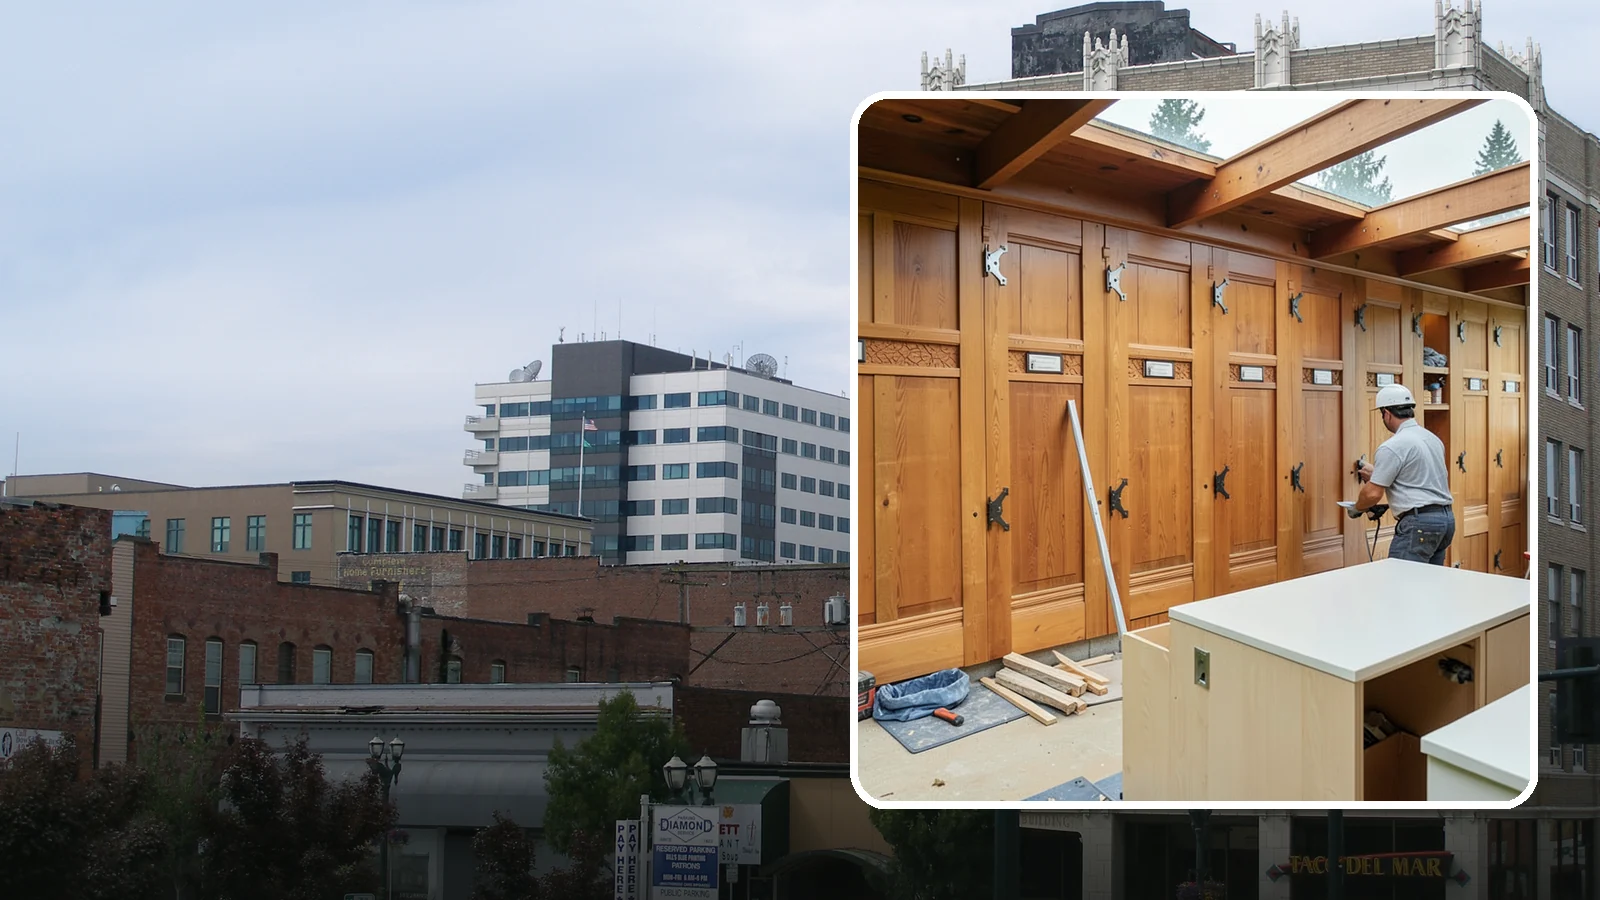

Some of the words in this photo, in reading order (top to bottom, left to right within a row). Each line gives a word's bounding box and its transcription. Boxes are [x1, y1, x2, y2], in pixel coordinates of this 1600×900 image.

[344, 568, 368, 577] Home
[371, 566, 427, 576] Furnishers
[660, 818, 713, 833] DIAMOND
[1021, 815, 1071, 828] BUILDING
[656, 845, 688, 853] RESERVED
[1346, 856, 1385, 876] DEL
[1392, 857, 1442, 877] MAR
[617, 856, 625, 893] HERE
[628, 855, 636, 893] HERE
[660, 888, 682, 897] PUBLIC
[684, 889, 711, 898] PARKING
